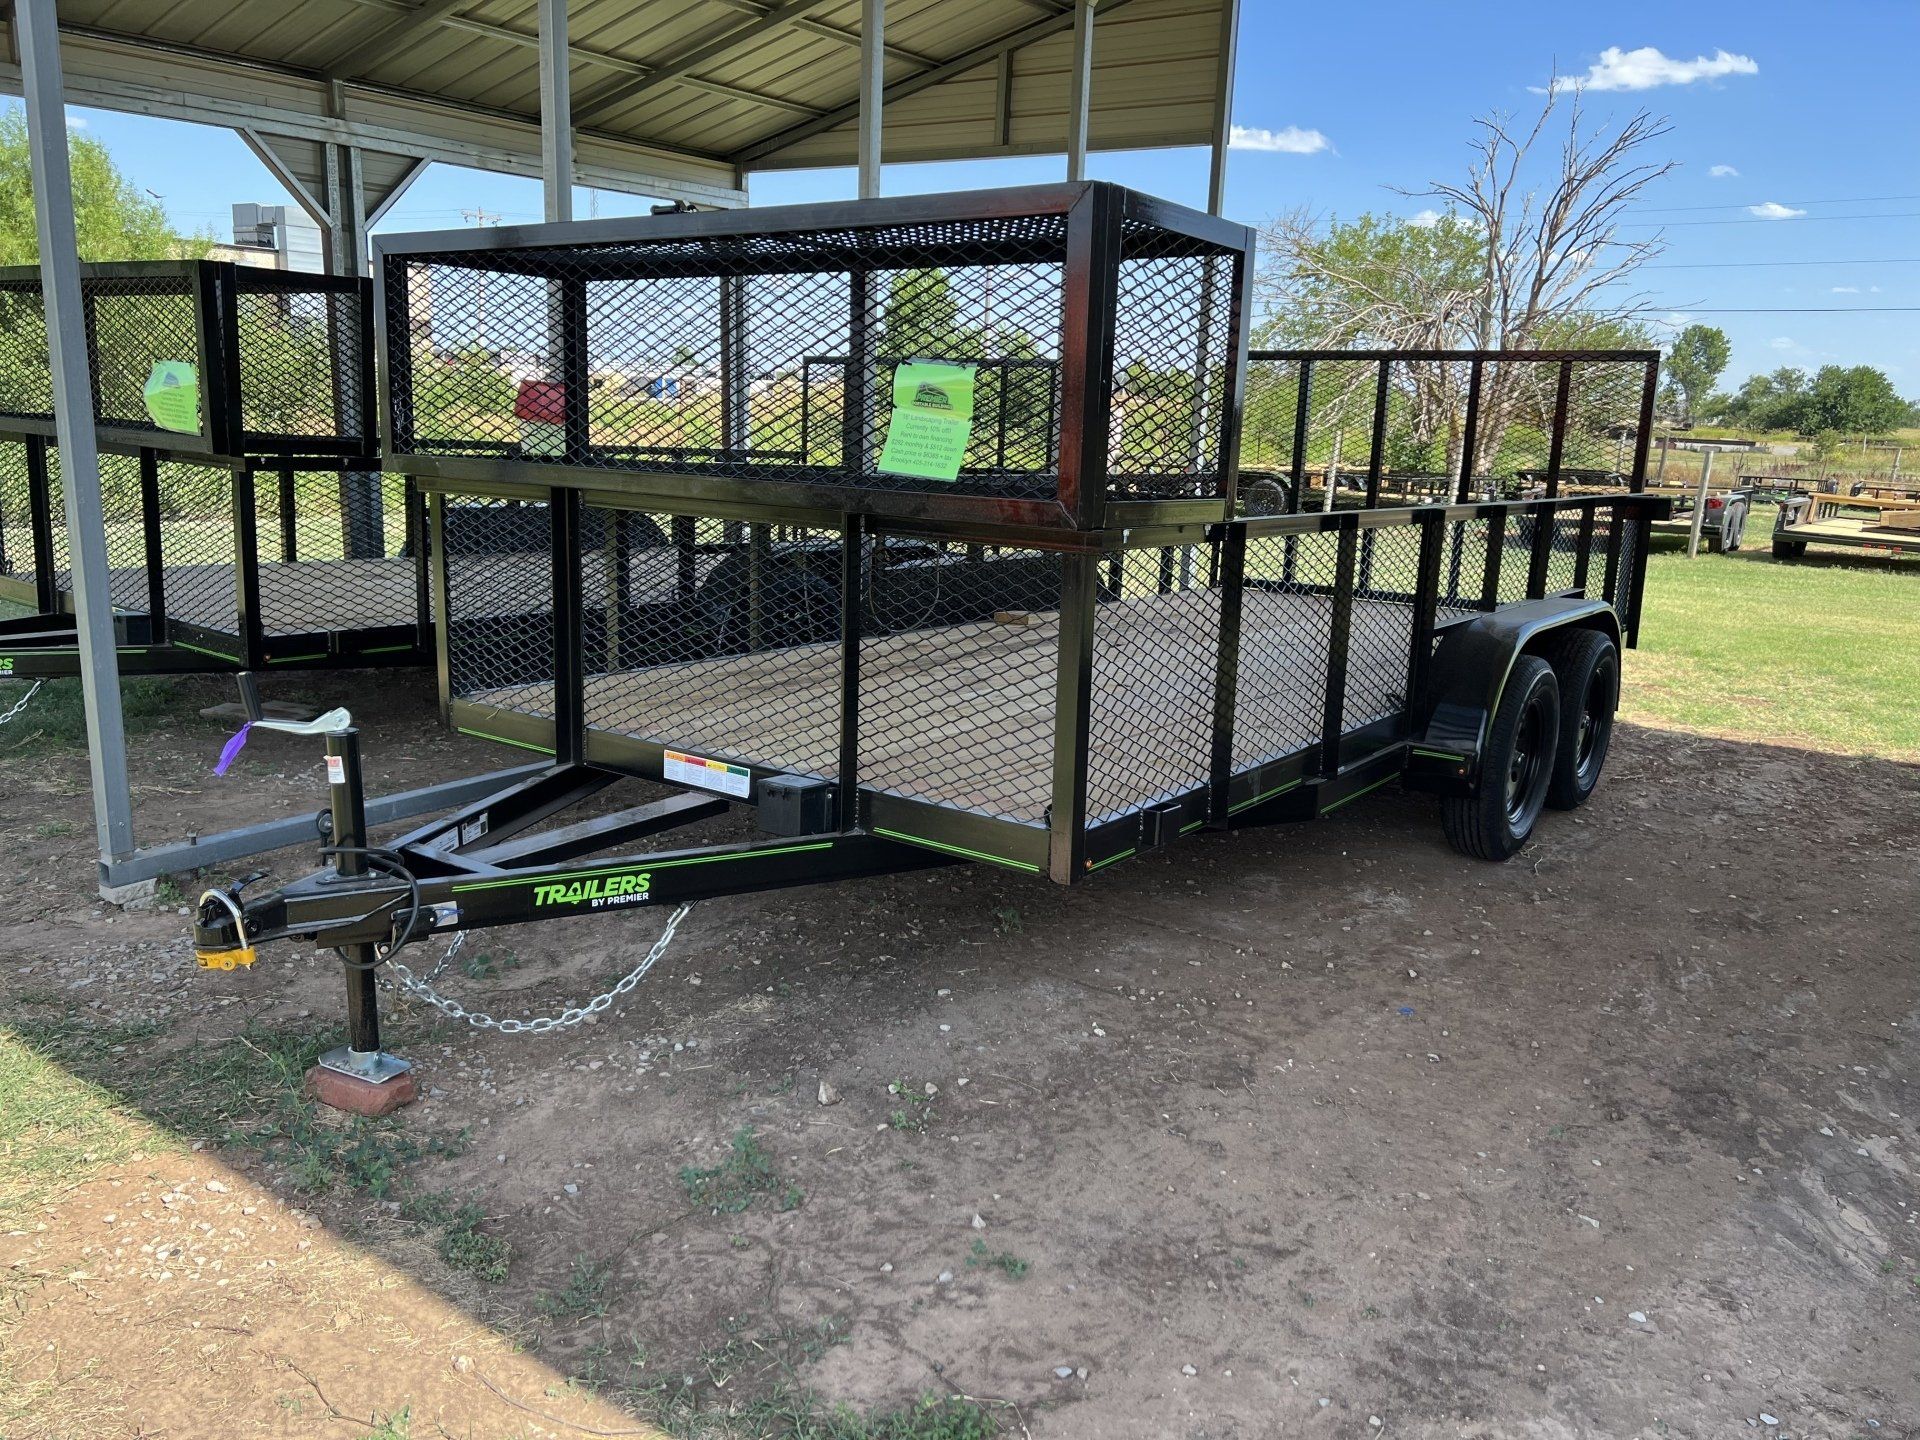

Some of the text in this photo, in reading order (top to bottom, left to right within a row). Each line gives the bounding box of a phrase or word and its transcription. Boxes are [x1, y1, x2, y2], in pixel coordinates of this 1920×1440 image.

[916, 393, 947, 403] PREMIER
[906, 423, 929, 433] Currently
[929, 434, 952, 444] financing
[533, 873, 651, 906] TRAILERS
[591, 892, 649, 907] BY PREMIER
